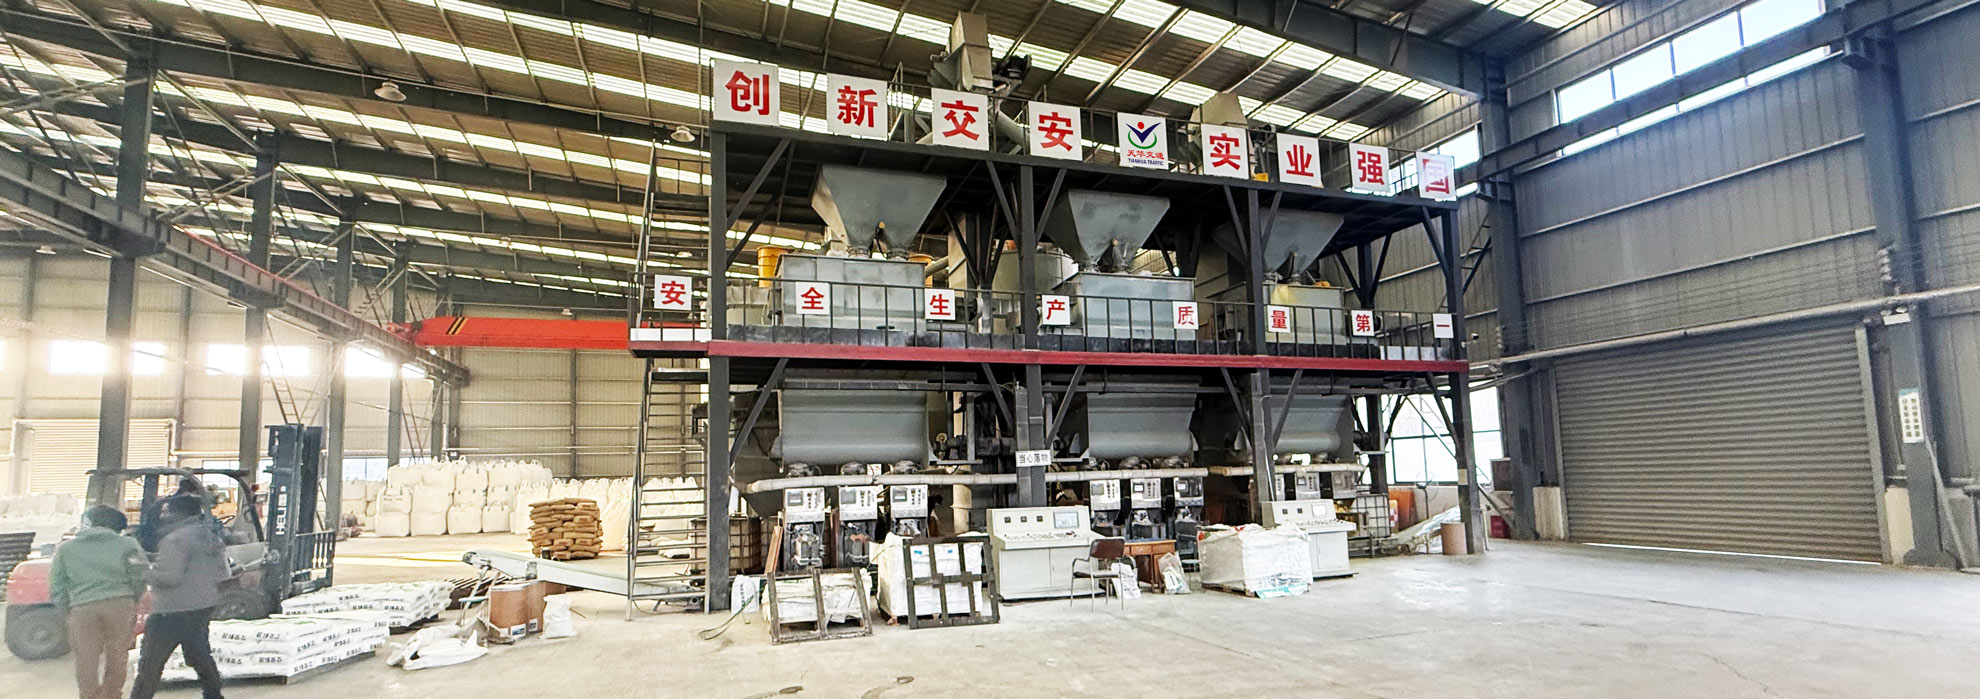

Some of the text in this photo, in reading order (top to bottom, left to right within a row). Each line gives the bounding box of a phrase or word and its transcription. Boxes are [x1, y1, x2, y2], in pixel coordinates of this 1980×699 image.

[725, 70, 771, 116] 创
[835, 84, 878, 129] 新
[939, 99, 980, 142] 交
[1037, 111, 1074, 153] 安
[1208, 131, 1241, 172] 实
[1285, 143, 1316, 178] 业
[1355, 149, 1386, 186] 强
[1127, 150, 1165, 160] 天华交通
[659, 280, 688, 307] 安
[800, 286, 826, 311] 全
[929, 293, 952, 317] 生
[1046, 298, 1066, 322] 产
[1177, 304, 1194, 326] 质
[1271, 308, 1288, 330] 量
[1355, 312, 1372, 333] 第
